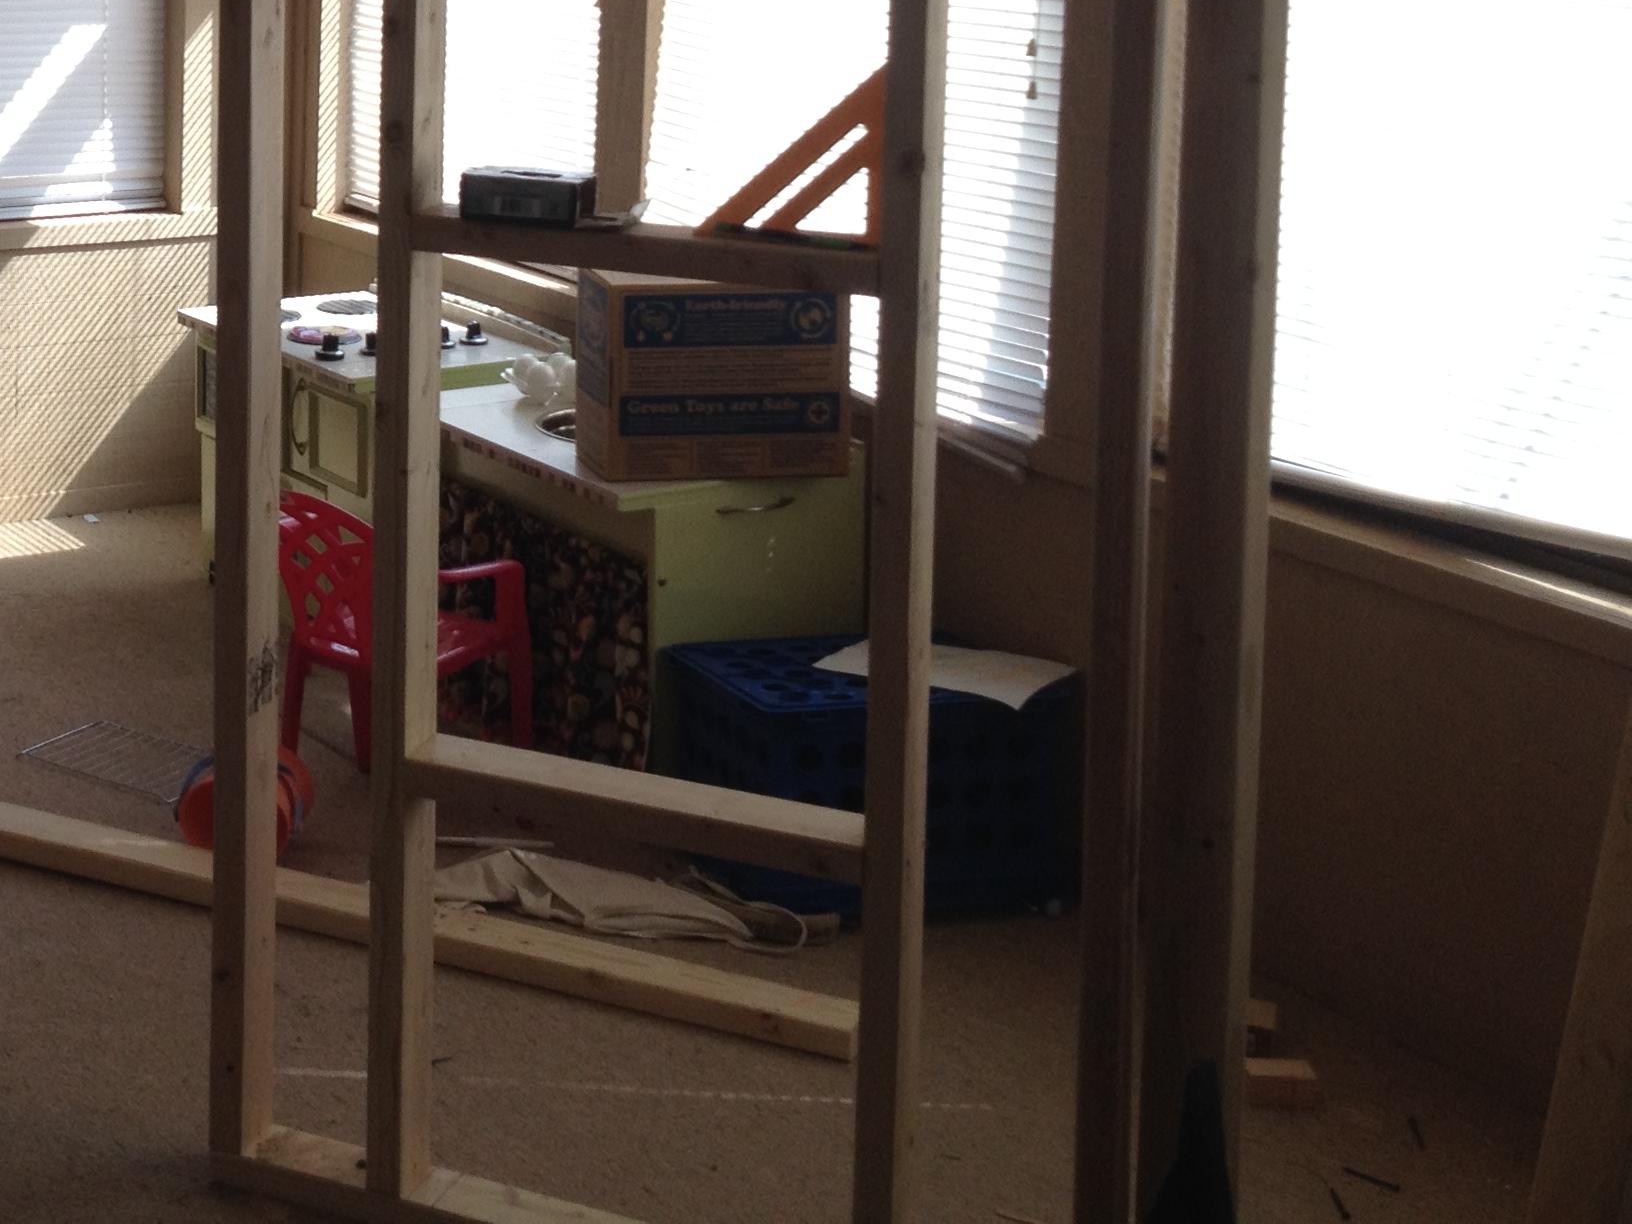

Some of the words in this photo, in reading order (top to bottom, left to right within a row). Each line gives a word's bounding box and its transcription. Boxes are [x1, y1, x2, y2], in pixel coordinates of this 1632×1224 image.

[627, 399, 680, 415] Green
[687, 398, 723, 416] Toys
[730, 401, 758, 412] are
